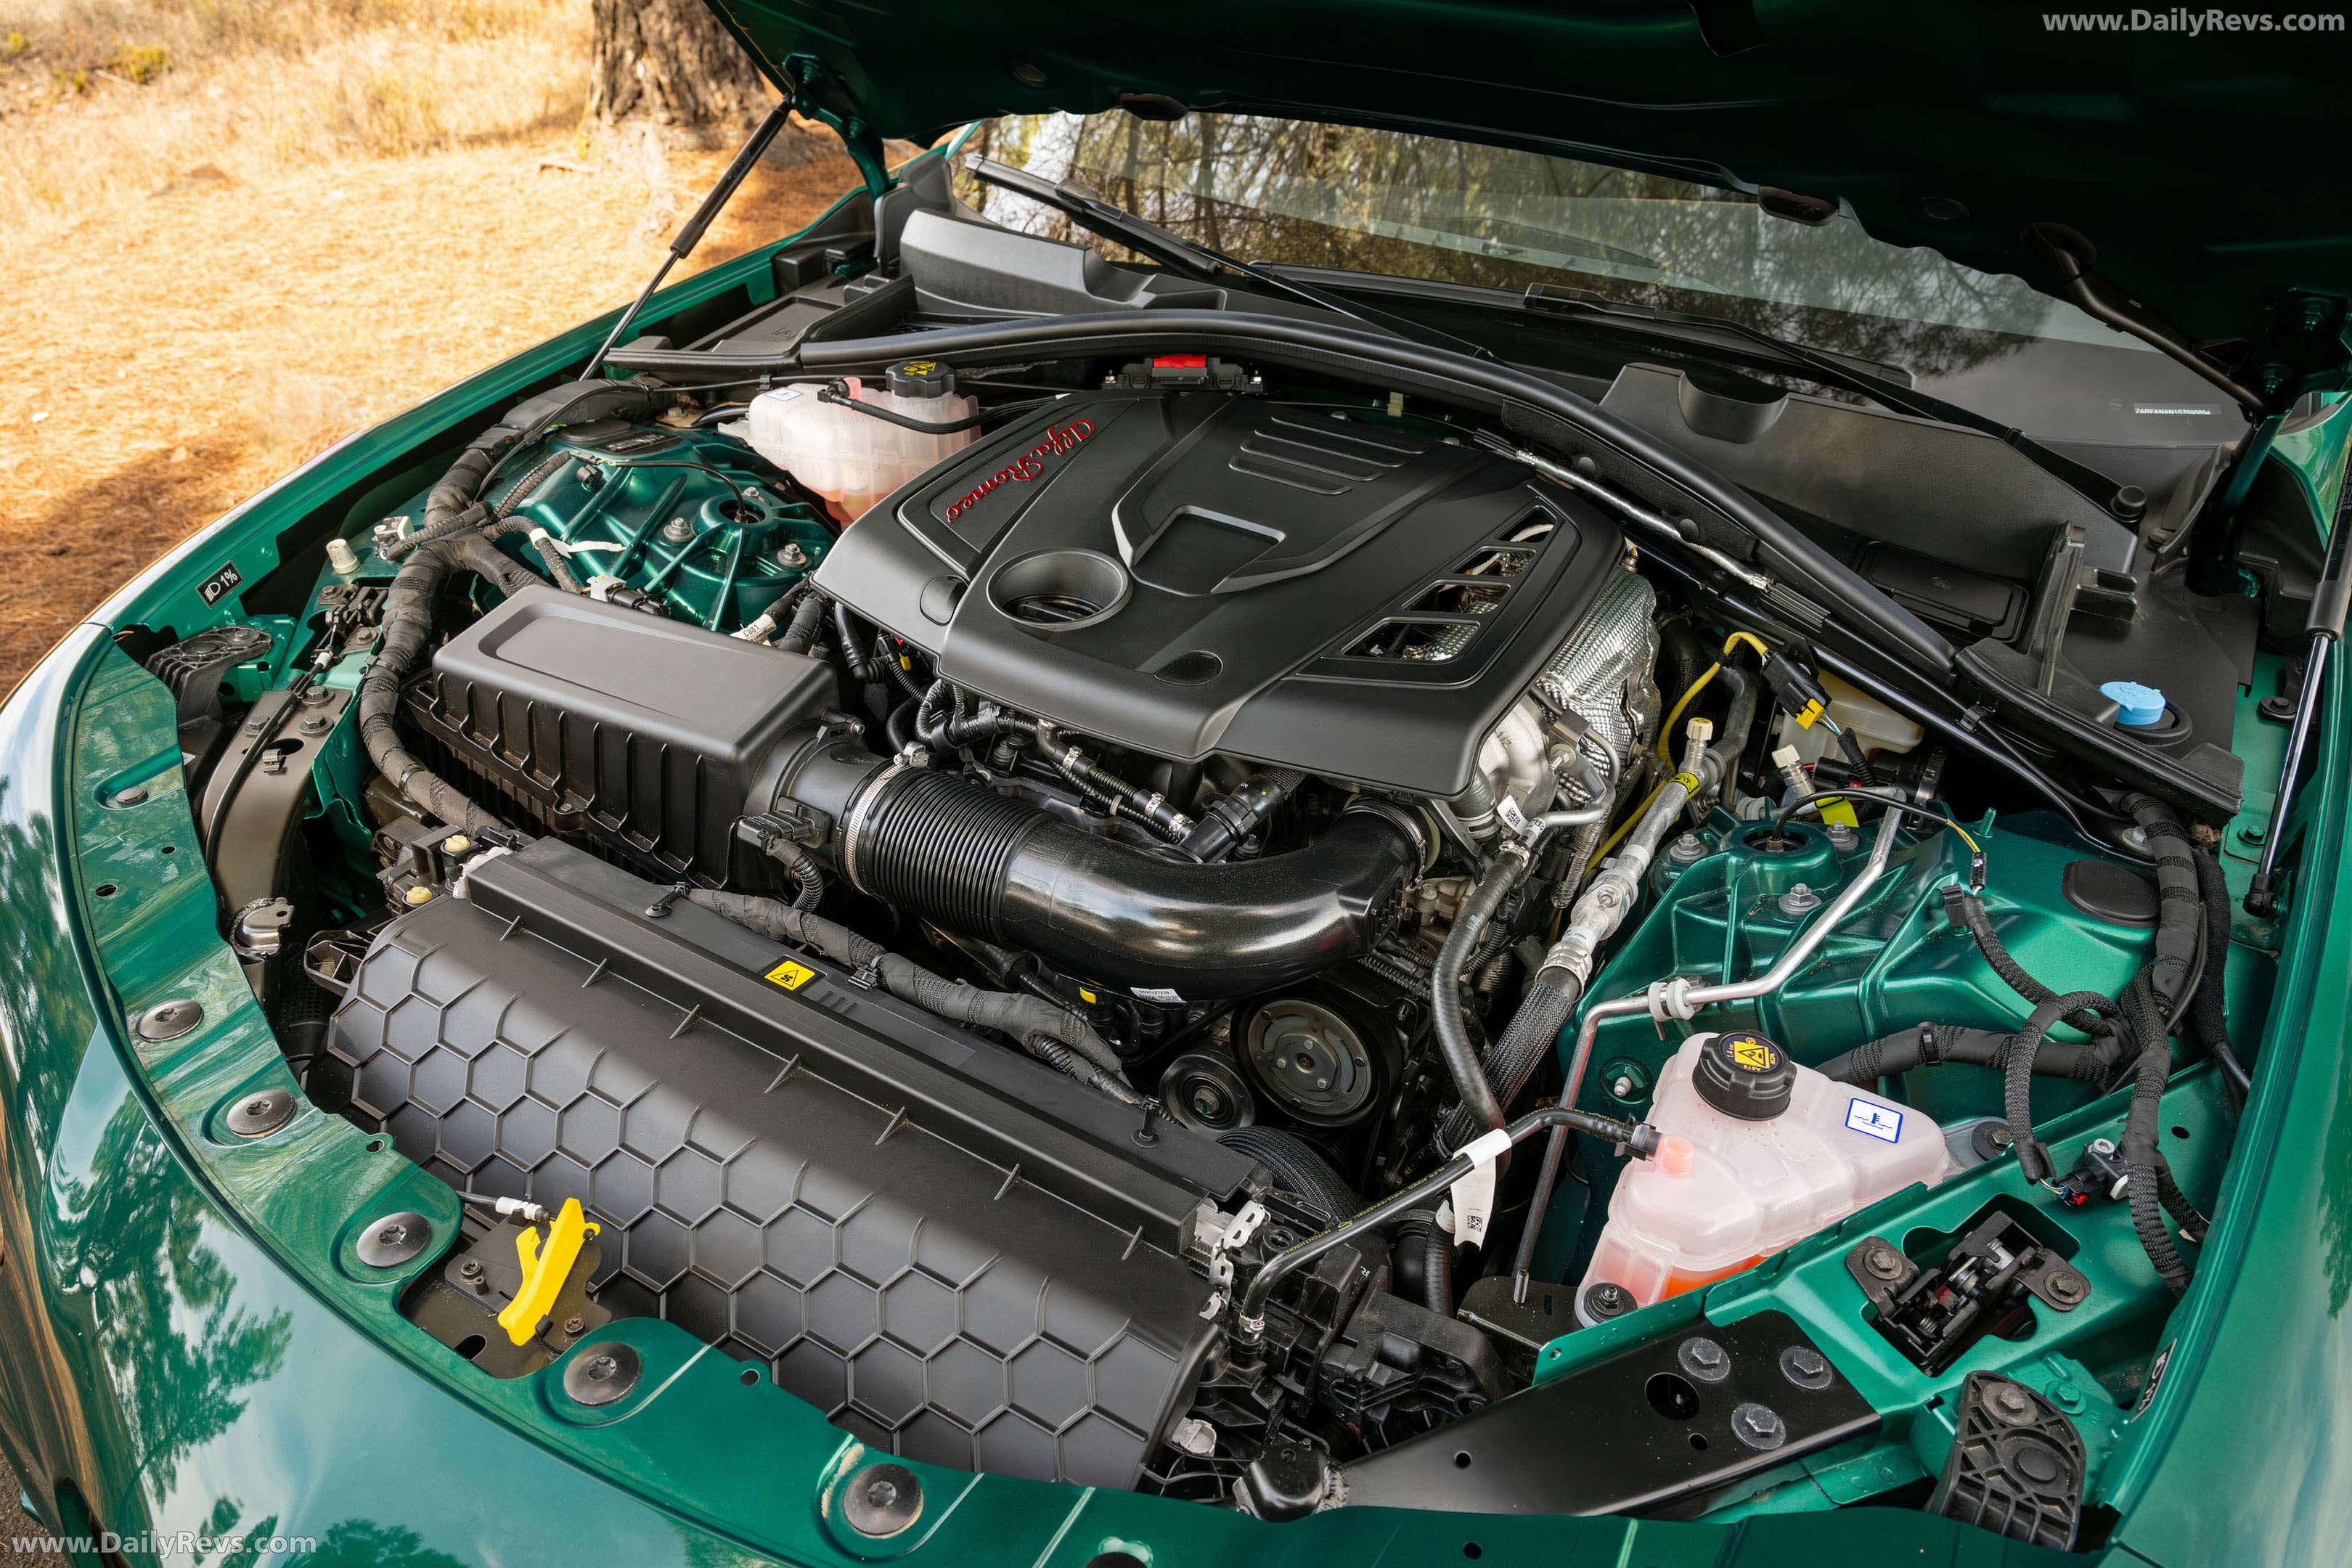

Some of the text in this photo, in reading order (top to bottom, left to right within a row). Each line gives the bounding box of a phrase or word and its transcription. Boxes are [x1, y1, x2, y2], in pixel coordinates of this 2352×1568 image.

[947, 419, 1095, 523] Alfa Romeo
[1286, 1228, 1331, 1254] HUTCHINSON
